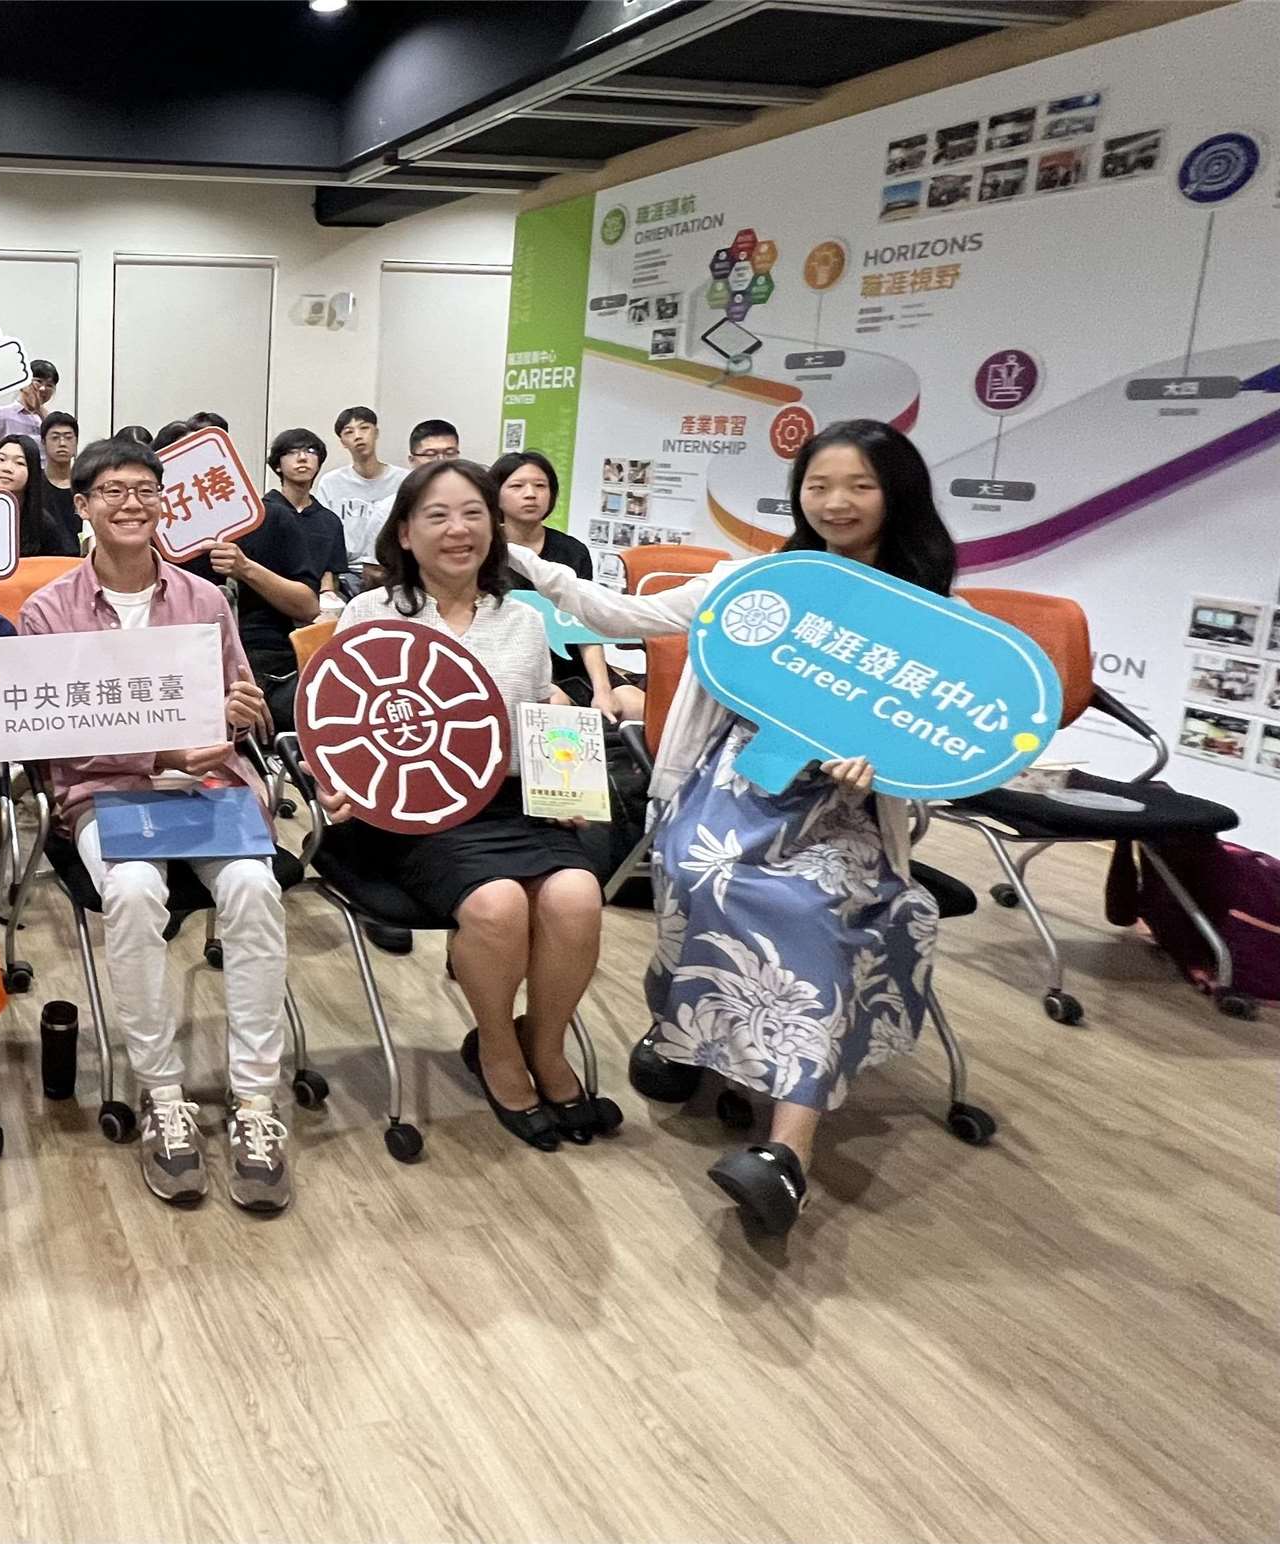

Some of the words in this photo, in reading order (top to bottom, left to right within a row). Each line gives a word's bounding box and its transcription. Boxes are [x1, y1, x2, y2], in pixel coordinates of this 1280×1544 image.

[634, 212, 724, 245] ORIENTATION
[863, 232, 984, 267] HORIZONS
[505, 366, 576, 390] CAREER
[662, 439, 747, 455] INTERNSHIP
[160, 464, 236, 529] 好棒
[978, 482, 1005, 496] 大三
[791, 611, 1010, 732] 職涯發展中心
[3, 674, 185, 711] 中央廣播電臺
[770, 644, 868, 702] Career
[872, 695, 986, 762] Center
[4, 716, 66, 733] RADIO
[68, 711, 140, 730] TAIWAN
[146, 707, 186, 724] INTL
